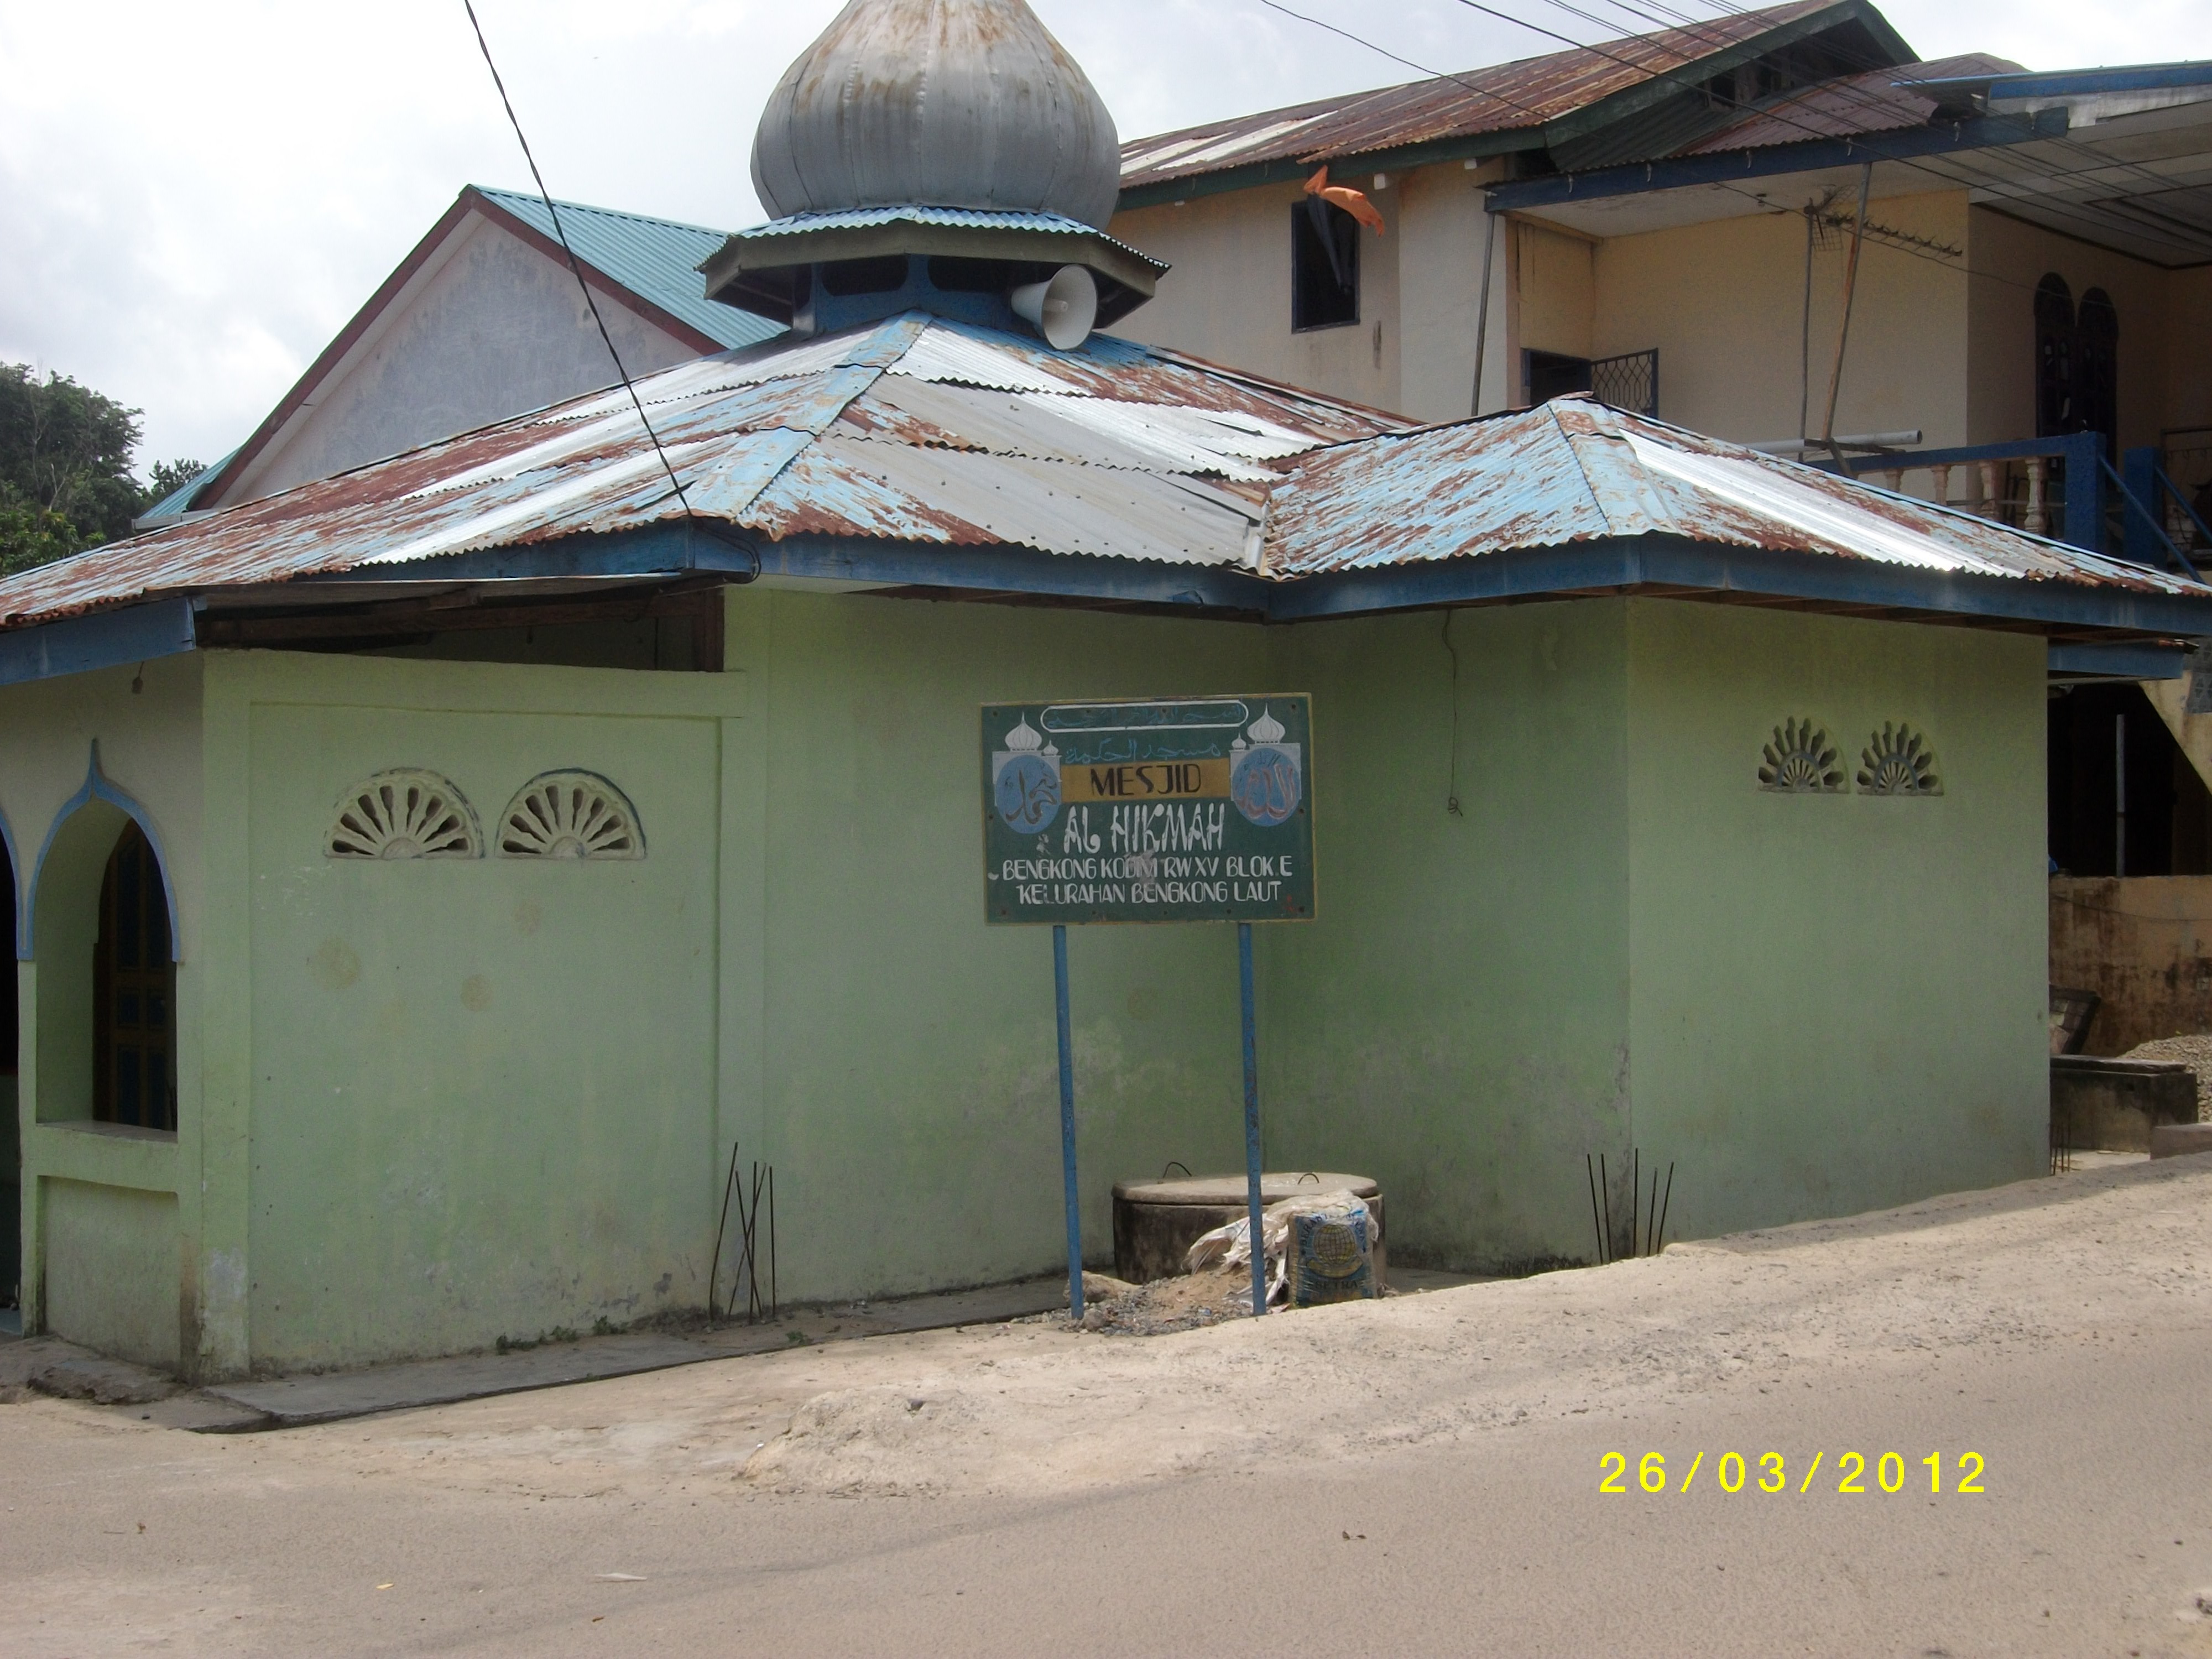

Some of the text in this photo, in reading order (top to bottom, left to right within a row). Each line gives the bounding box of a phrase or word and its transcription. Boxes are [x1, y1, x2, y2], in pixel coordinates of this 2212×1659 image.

[1090, 763, 1202, 797] MESJID
[1063, 802, 1225, 853] AL HIKMAH
[1003, 858, 1097, 881] BENGKONG
[1164, 857, 1192, 878] RW
[1194, 857, 1219, 877] XV
[1015, 880, 1282, 905] KELURAHAN BENGKONG LAUT
